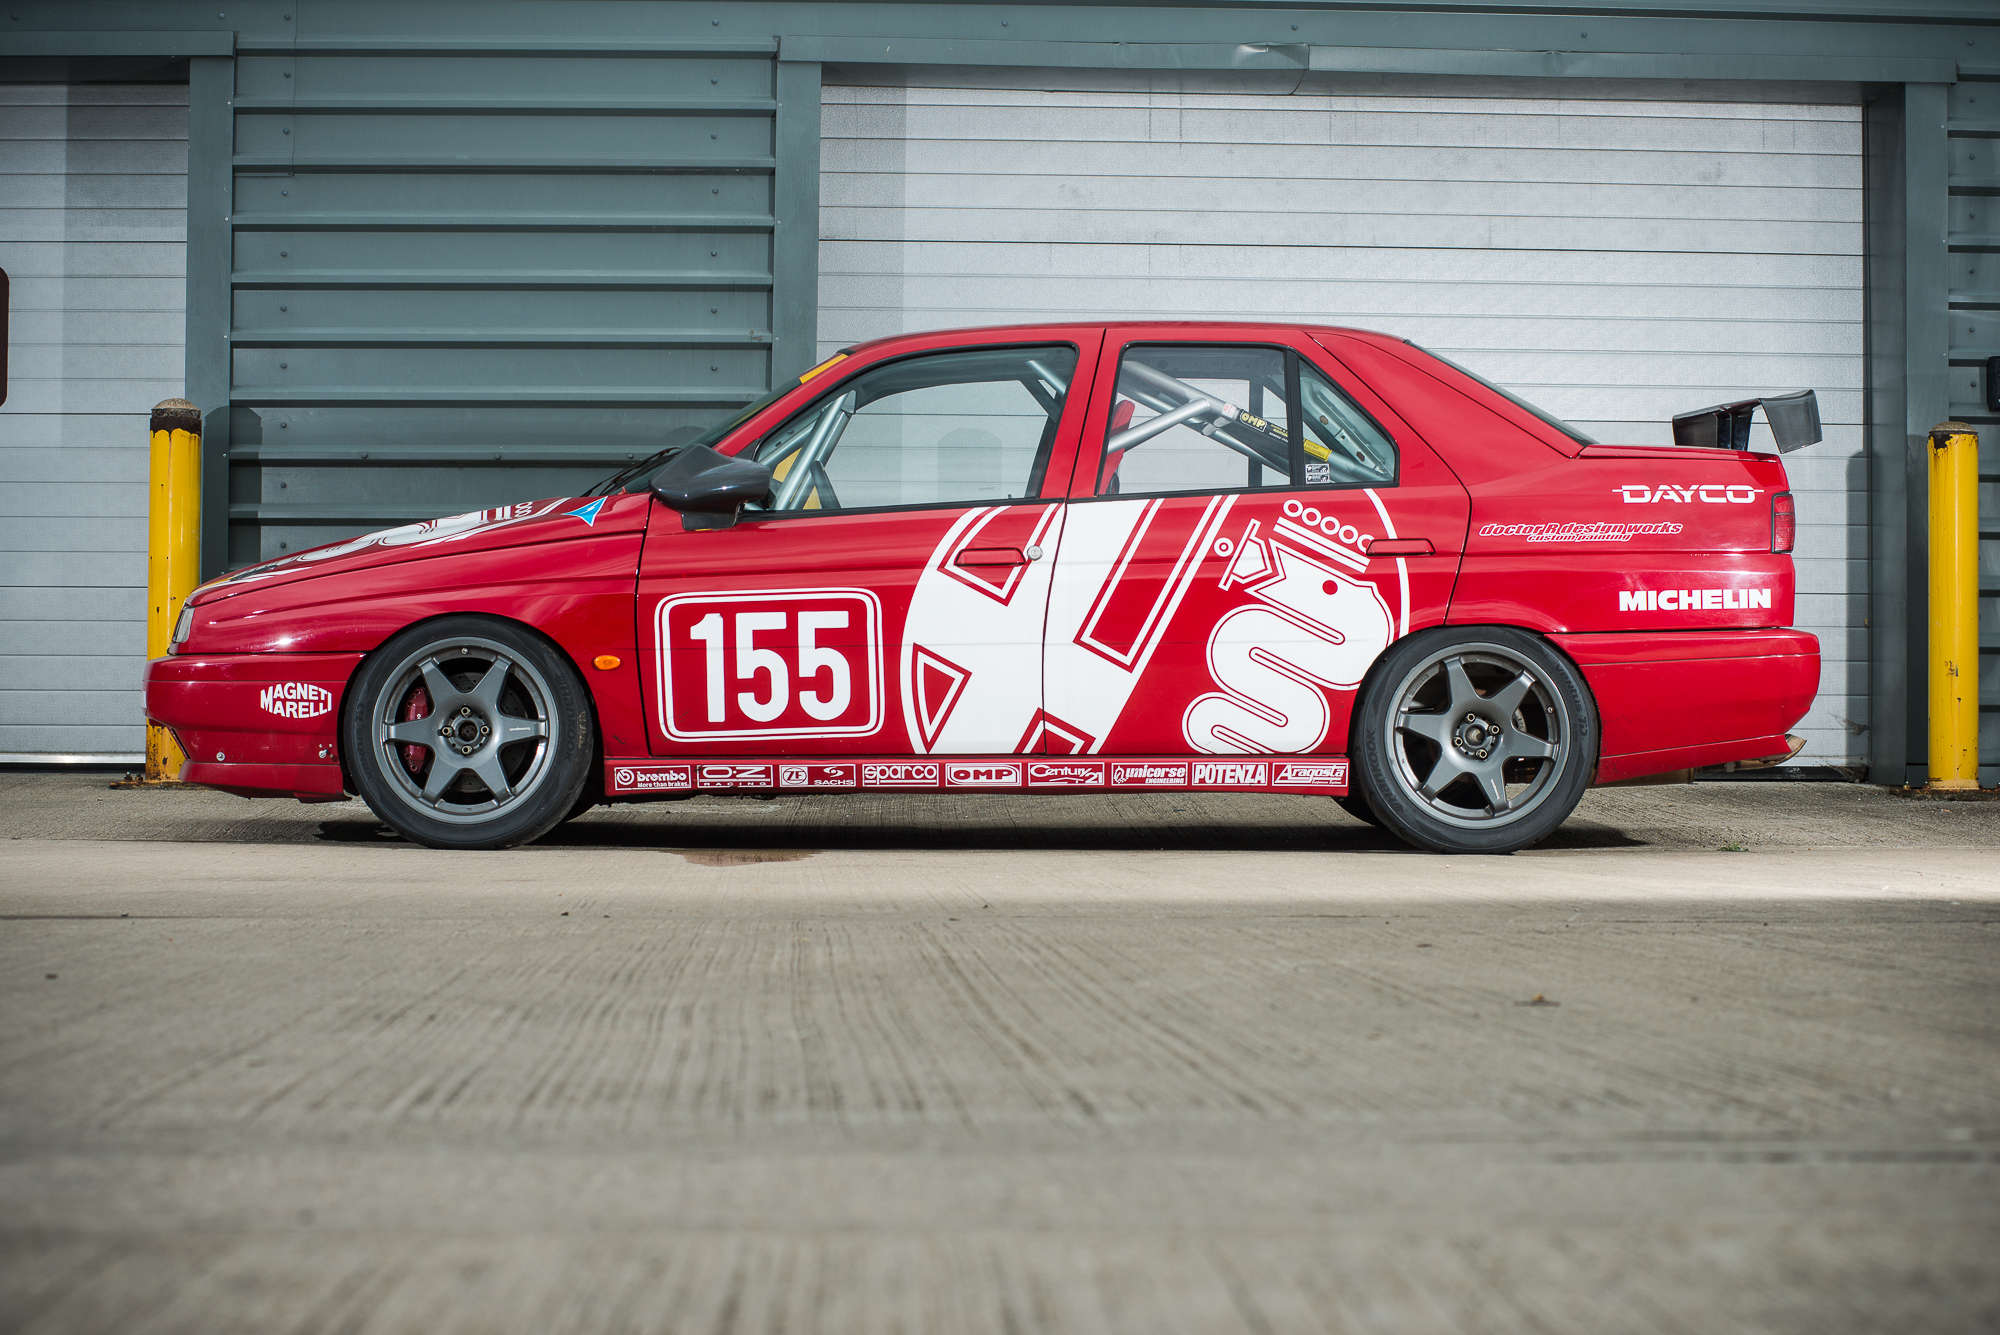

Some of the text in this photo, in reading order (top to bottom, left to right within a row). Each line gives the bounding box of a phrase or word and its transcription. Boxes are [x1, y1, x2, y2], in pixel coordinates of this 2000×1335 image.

[1621, 484, 1756, 504] DAYCO
[1479, 521, 1684, 536] doctor R design works
[1527, 533, 1634, 542] custom painting
[1618, 588, 1772, 611] MICHELIN
[690, 611, 851, 722] 155
[260, 682, 332, 709] MAGNETI
[260, 692, 332, 719] MARELLI
[637, 770, 687, 781] brembo
[785, 768, 805, 782] ZF
[864, 765, 937, 785] sparco
[953, 769, 1013, 780] OMP
[1030, 764, 1102, 784] Century 21
[1126, 764, 1186, 778] unicorse
[1194, 764, 1266, 784] POTENZA
[1274, 764, 1346, 783] Aragosta
